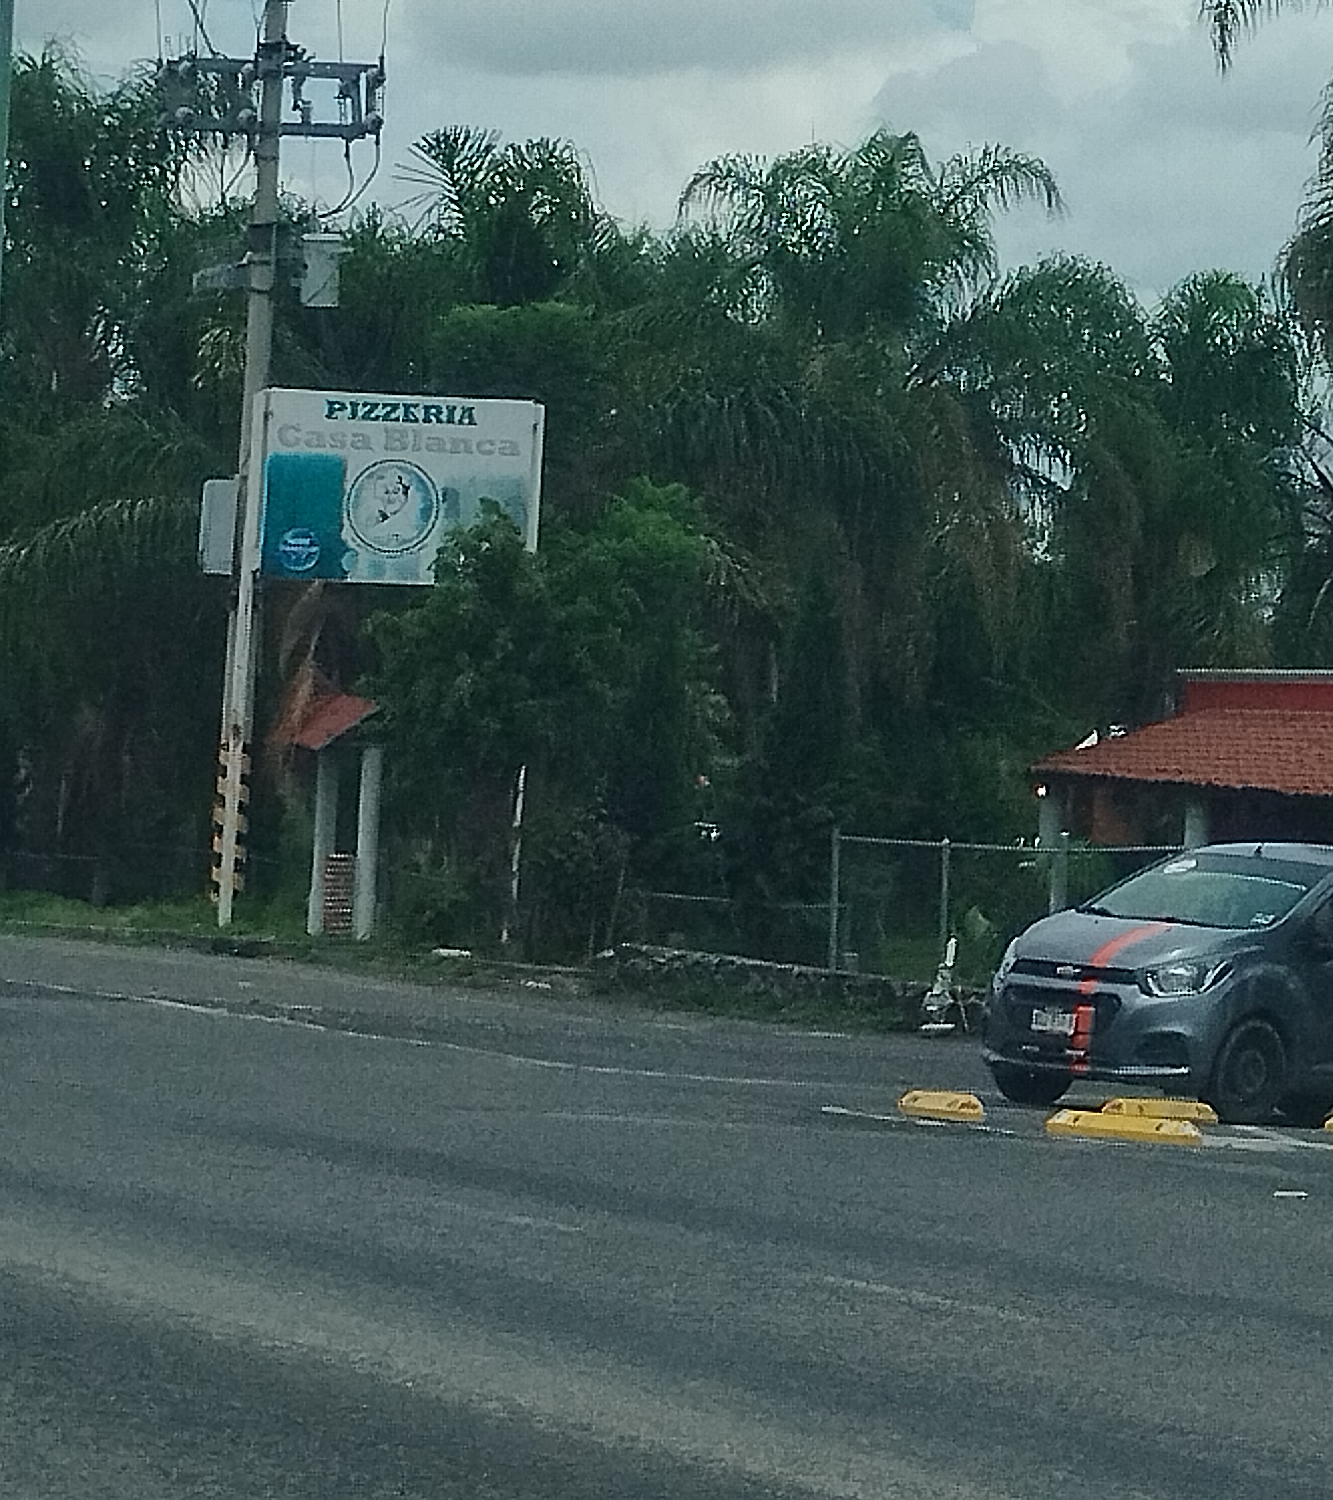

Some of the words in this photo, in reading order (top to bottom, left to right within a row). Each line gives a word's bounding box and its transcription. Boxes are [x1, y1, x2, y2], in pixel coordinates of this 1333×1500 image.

[325, 399, 477, 426] PIZZERIA
[277, 422, 373, 451] Casa
[383, 425, 521, 457] Blanca
